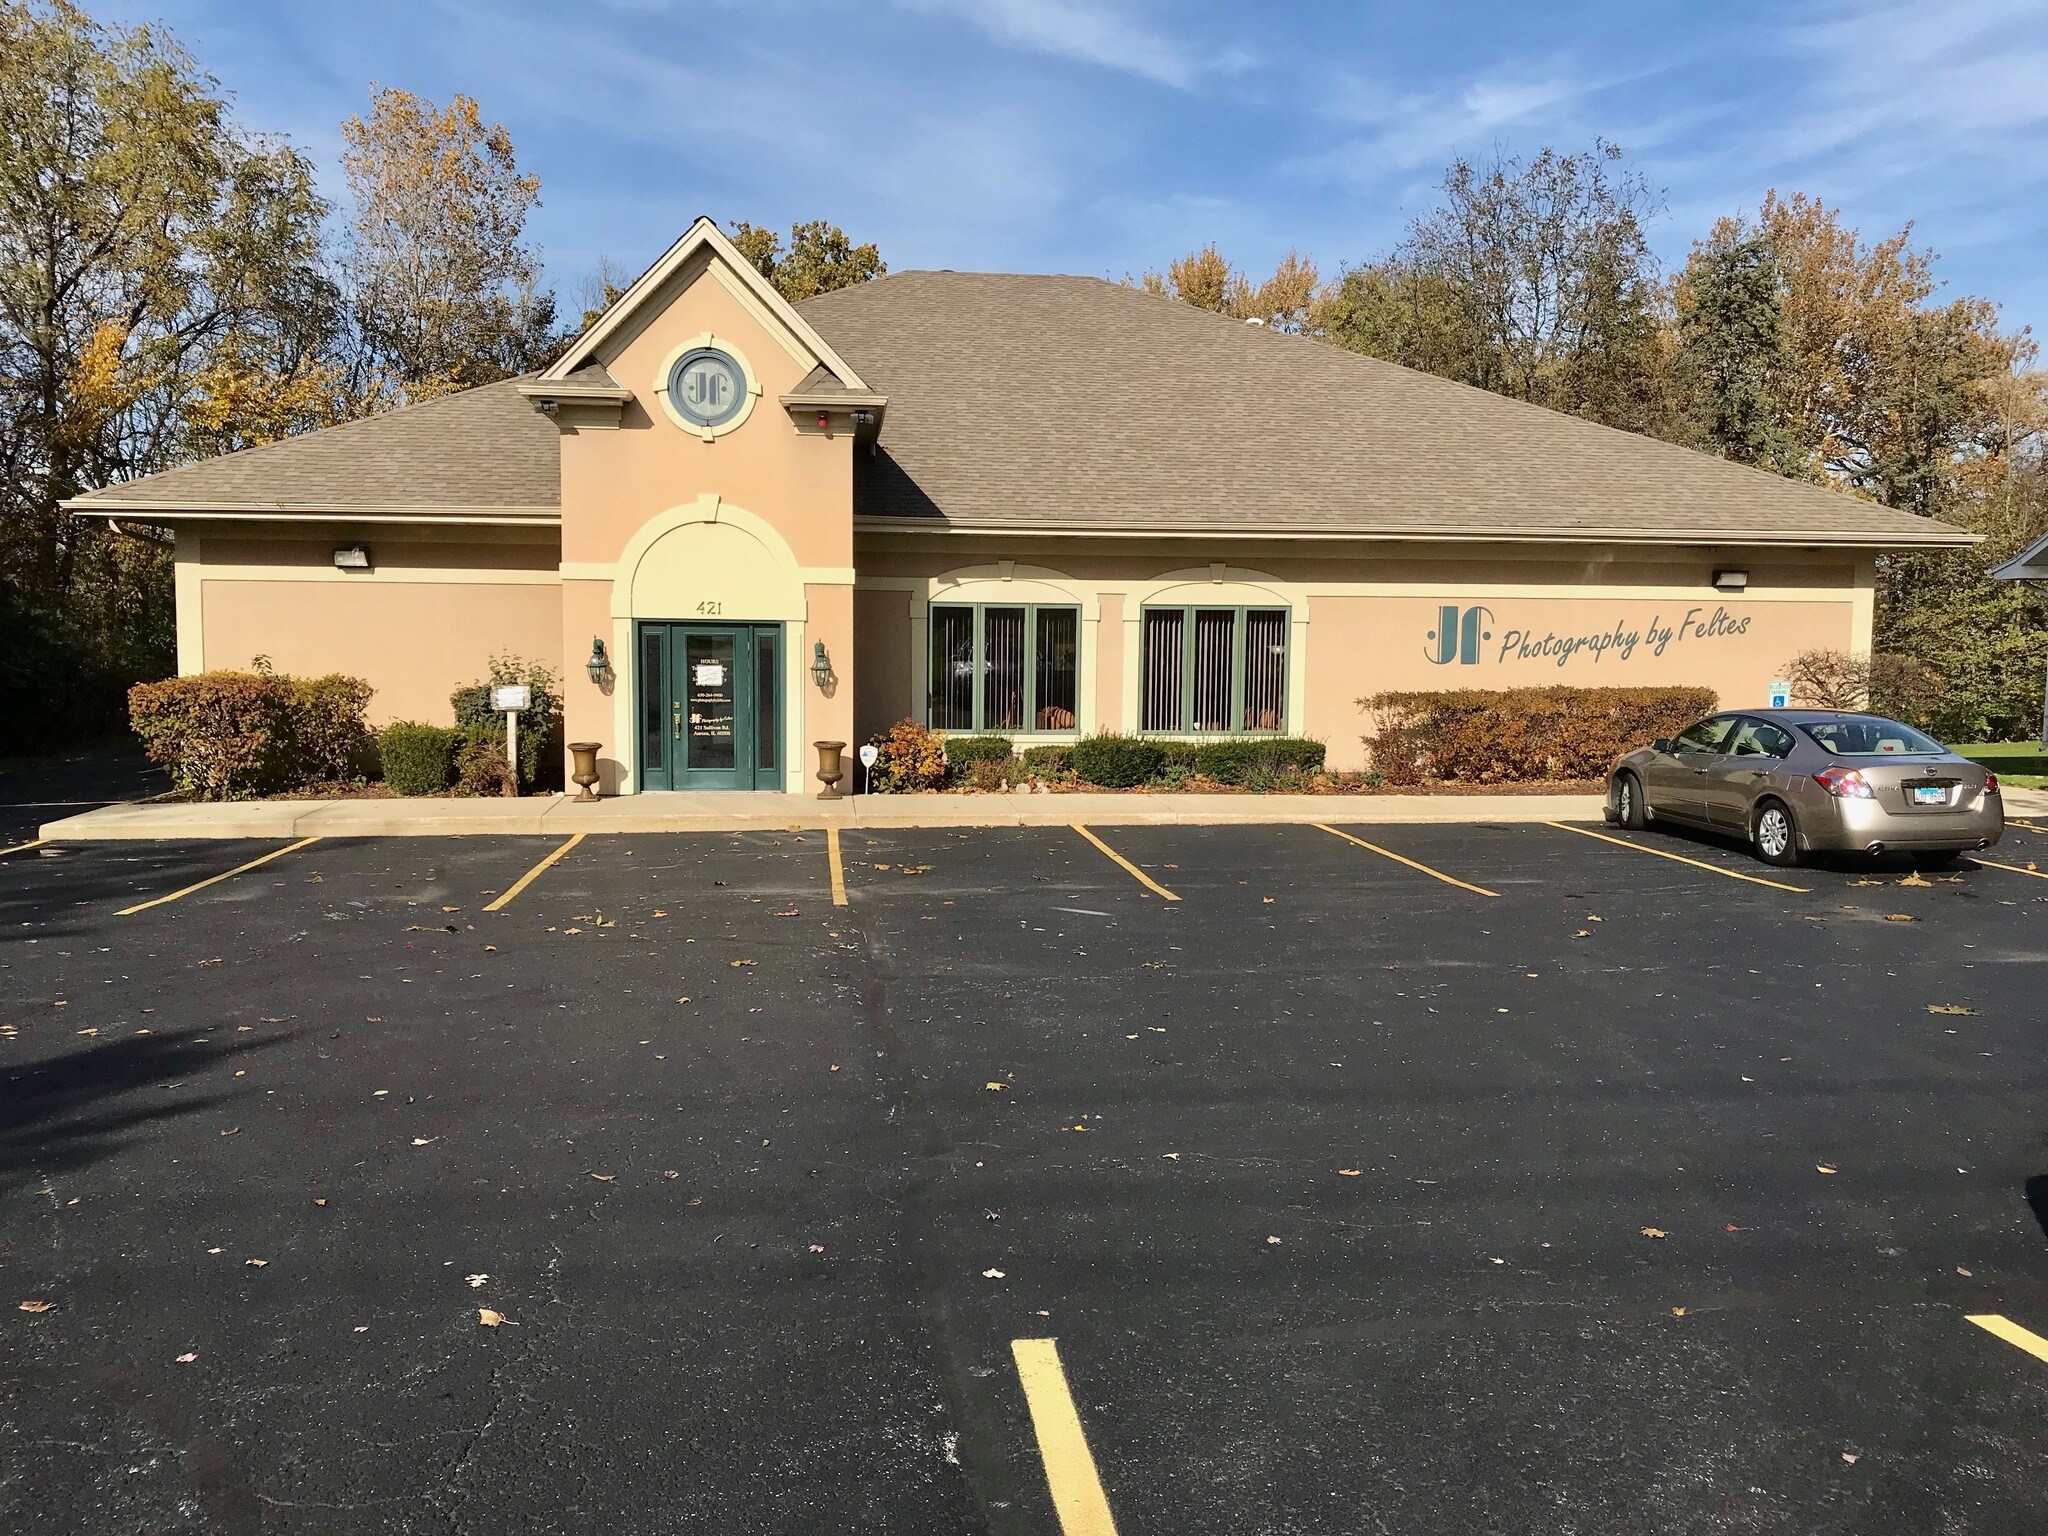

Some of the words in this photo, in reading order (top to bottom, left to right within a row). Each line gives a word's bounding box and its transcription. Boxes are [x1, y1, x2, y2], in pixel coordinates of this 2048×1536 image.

[696, 601, 722, 615] 421
[1498, 619, 1640, 667] Photography
[1645, 615, 1673, 657] by
[1678, 606, 1752, 642] Feltes
